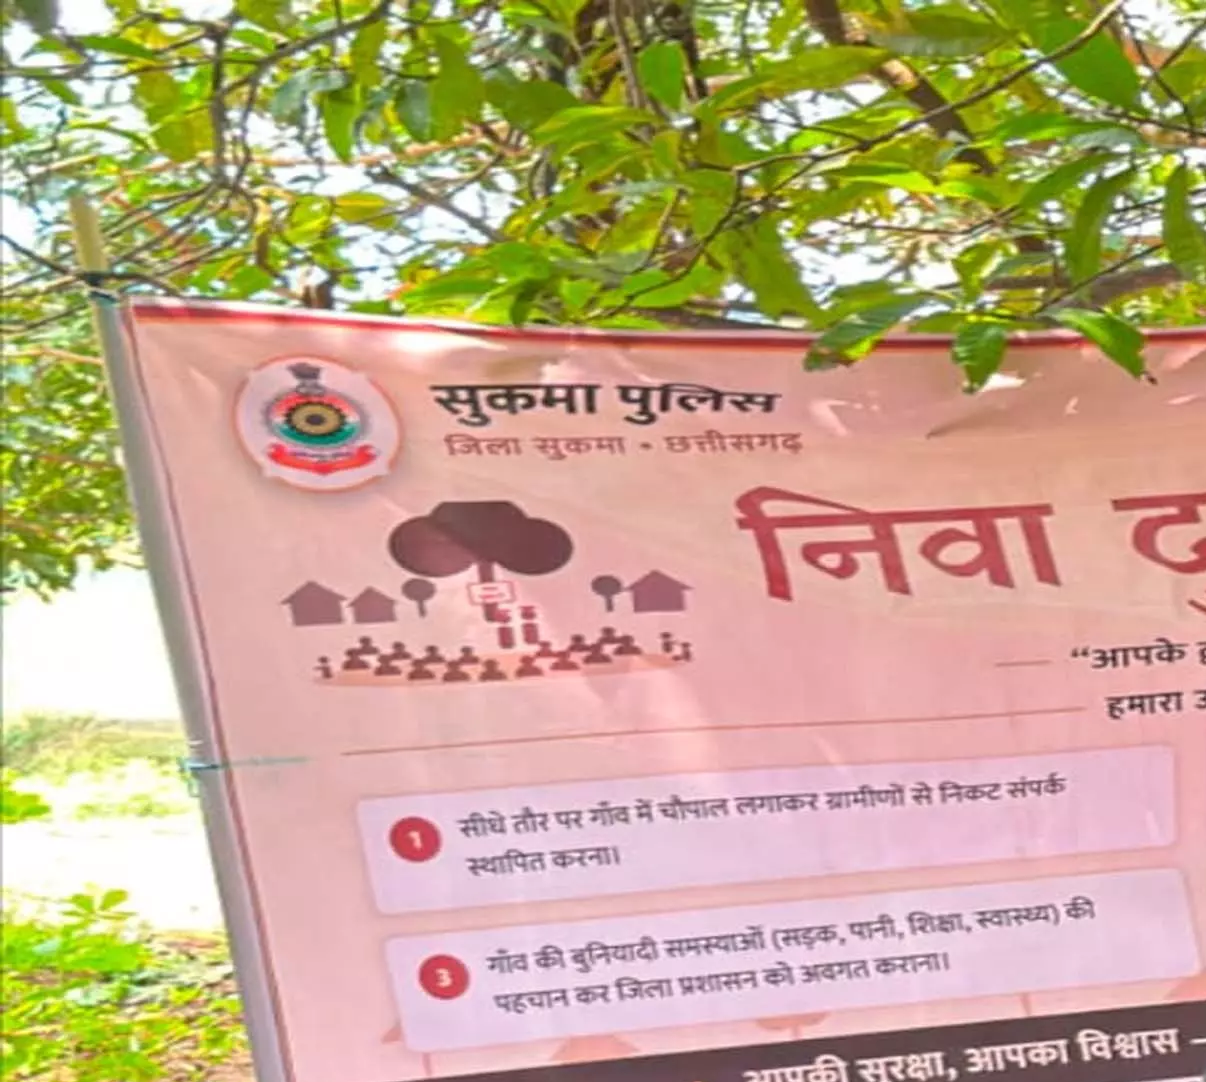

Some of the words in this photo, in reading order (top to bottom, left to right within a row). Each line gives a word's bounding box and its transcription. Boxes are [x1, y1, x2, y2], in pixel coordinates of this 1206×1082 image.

[429, 384, 602, 427] सुकमा
[615, 383, 782, 425] पुलिस
[444, 433, 522, 456] जिला
[535, 435, 626, 461] सुकमा
[735, 485, 1063, 602] निवा
[1105, 690, 1184, 720] हमारा
[457, 811, 508, 838] सीधे
[512, 806, 550, 835] तौर
[555, 809, 584, 830] पर
[634, 797, 655, 823] में
[657, 794, 730, 821] चौपाल
[735, 791, 818, 815] लगाकर
[825, 783, 905, 810] ग्रामीणों
[909, 780, 934, 805] से
[938, 780, 1002, 803] निकट
[1005, 771, 1067, 799] संपर्क
[466, 848, 547, 877] स्थापित
[535, 944, 566, 971] की
[570, 935, 659, 973] बुनियादी
[662, 924, 766, 958] समस्याओं
[1063, 896, 1096, 920] की
[493, 990, 571, 1014] पहचान
[575, 983, 610, 1007] कर
[615, 976, 675, 1002] जिला
[677, 970, 758, 994] प्रशासन
[764, 961, 796, 987] को
[800, 962, 870, 985] अवगत
[965, 1037, 1070, 1075] आपका
[1075, 1027, 1182, 1062] विश्वास
